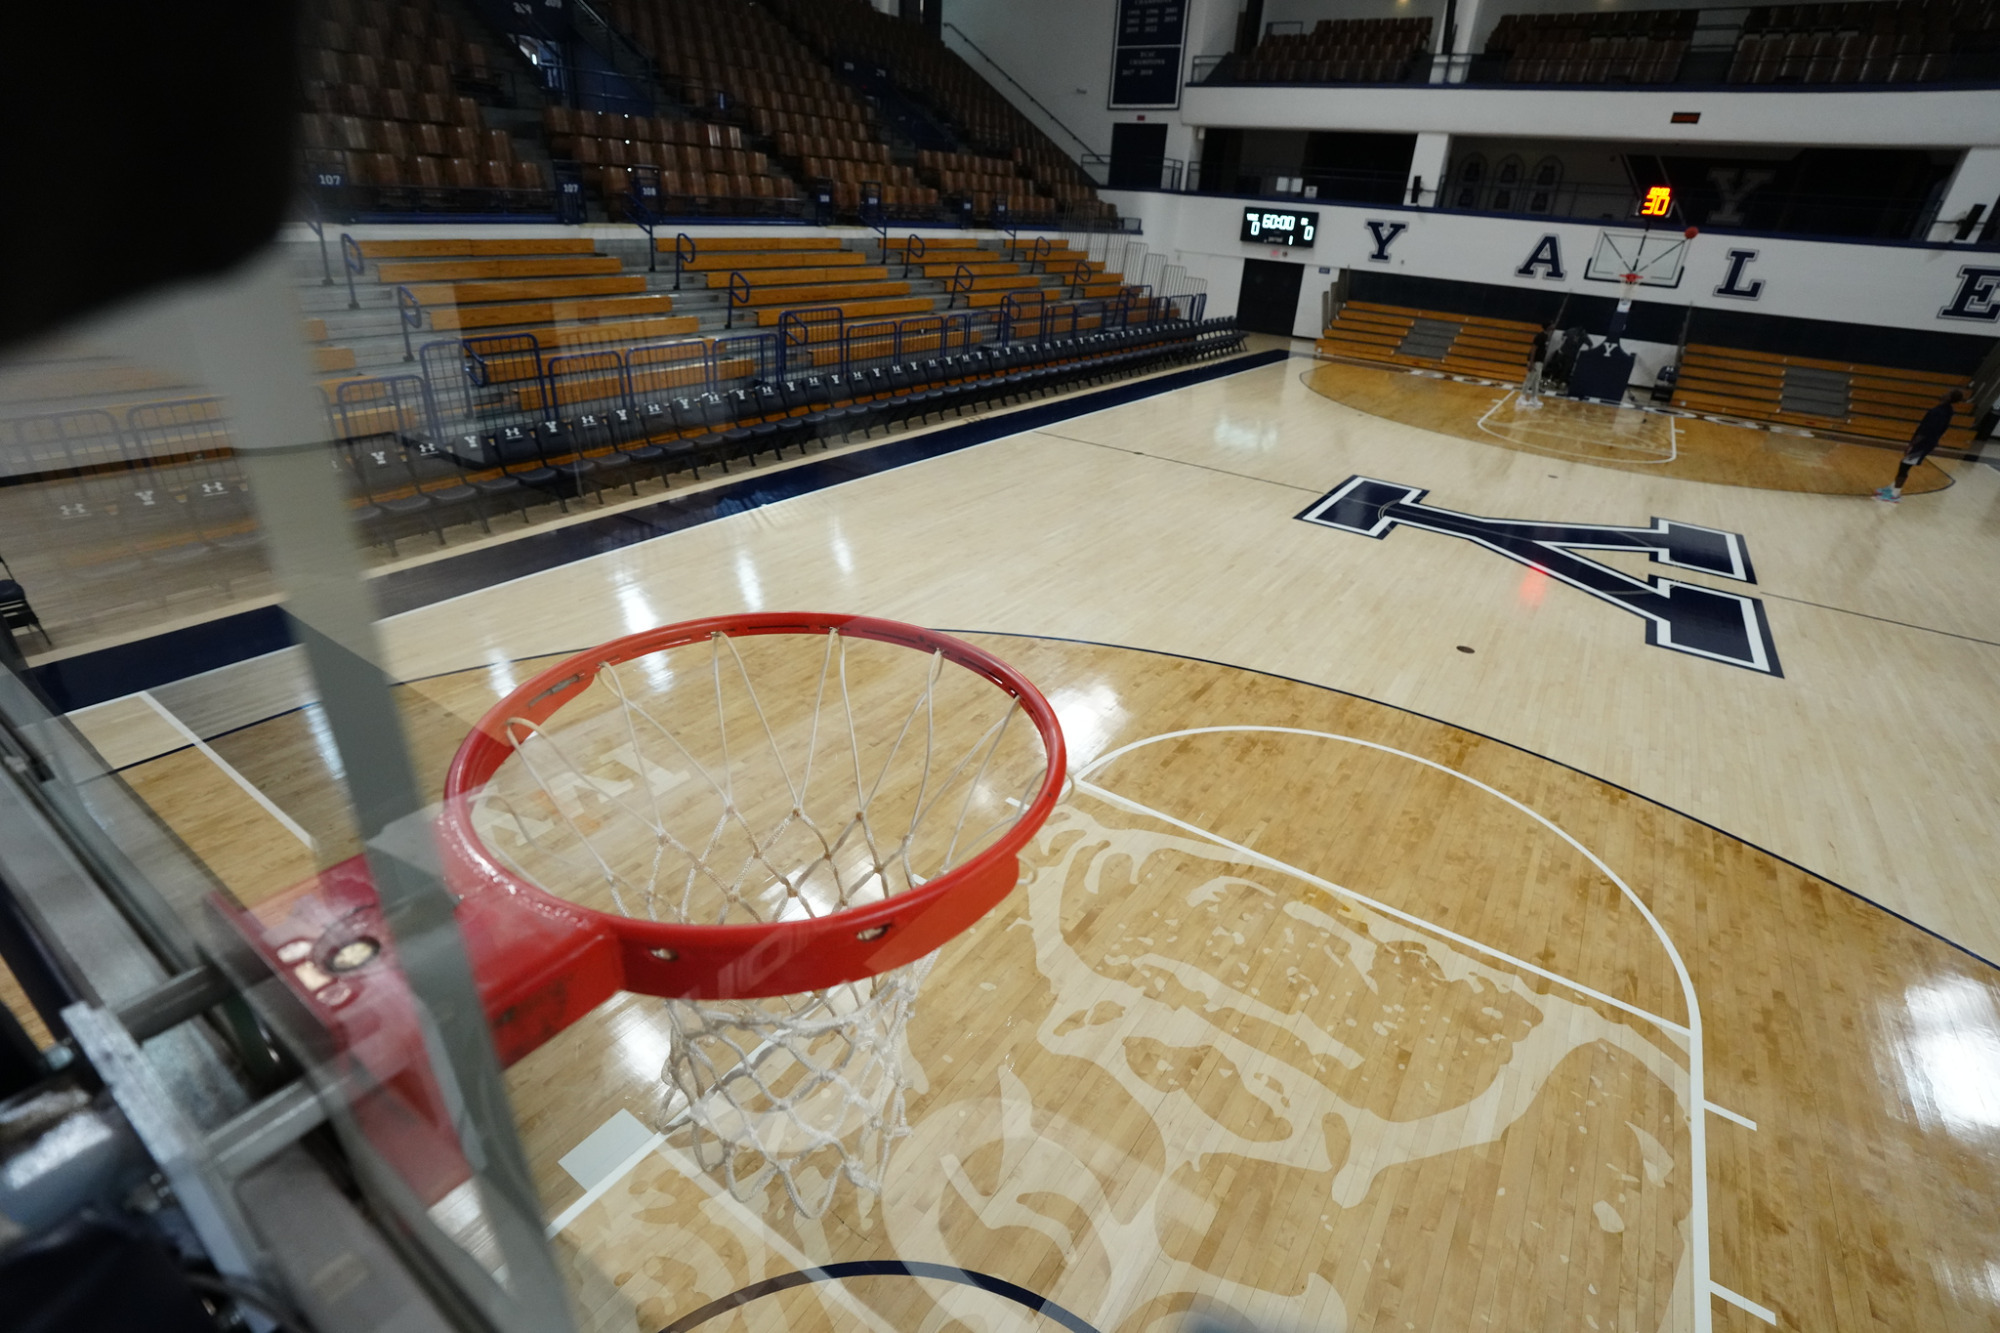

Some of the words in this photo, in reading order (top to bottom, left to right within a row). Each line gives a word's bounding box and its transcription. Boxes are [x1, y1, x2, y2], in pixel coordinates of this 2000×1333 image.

[319, 174, 341, 185] 107
[1641, 194, 1670, 215] 30
[1706, 167, 1776, 226] Y
[1262, 213, 1295, 231] 60:00
[1603, 342, 1618, 357] Y
[1293, 474, 1785, 679] Y
